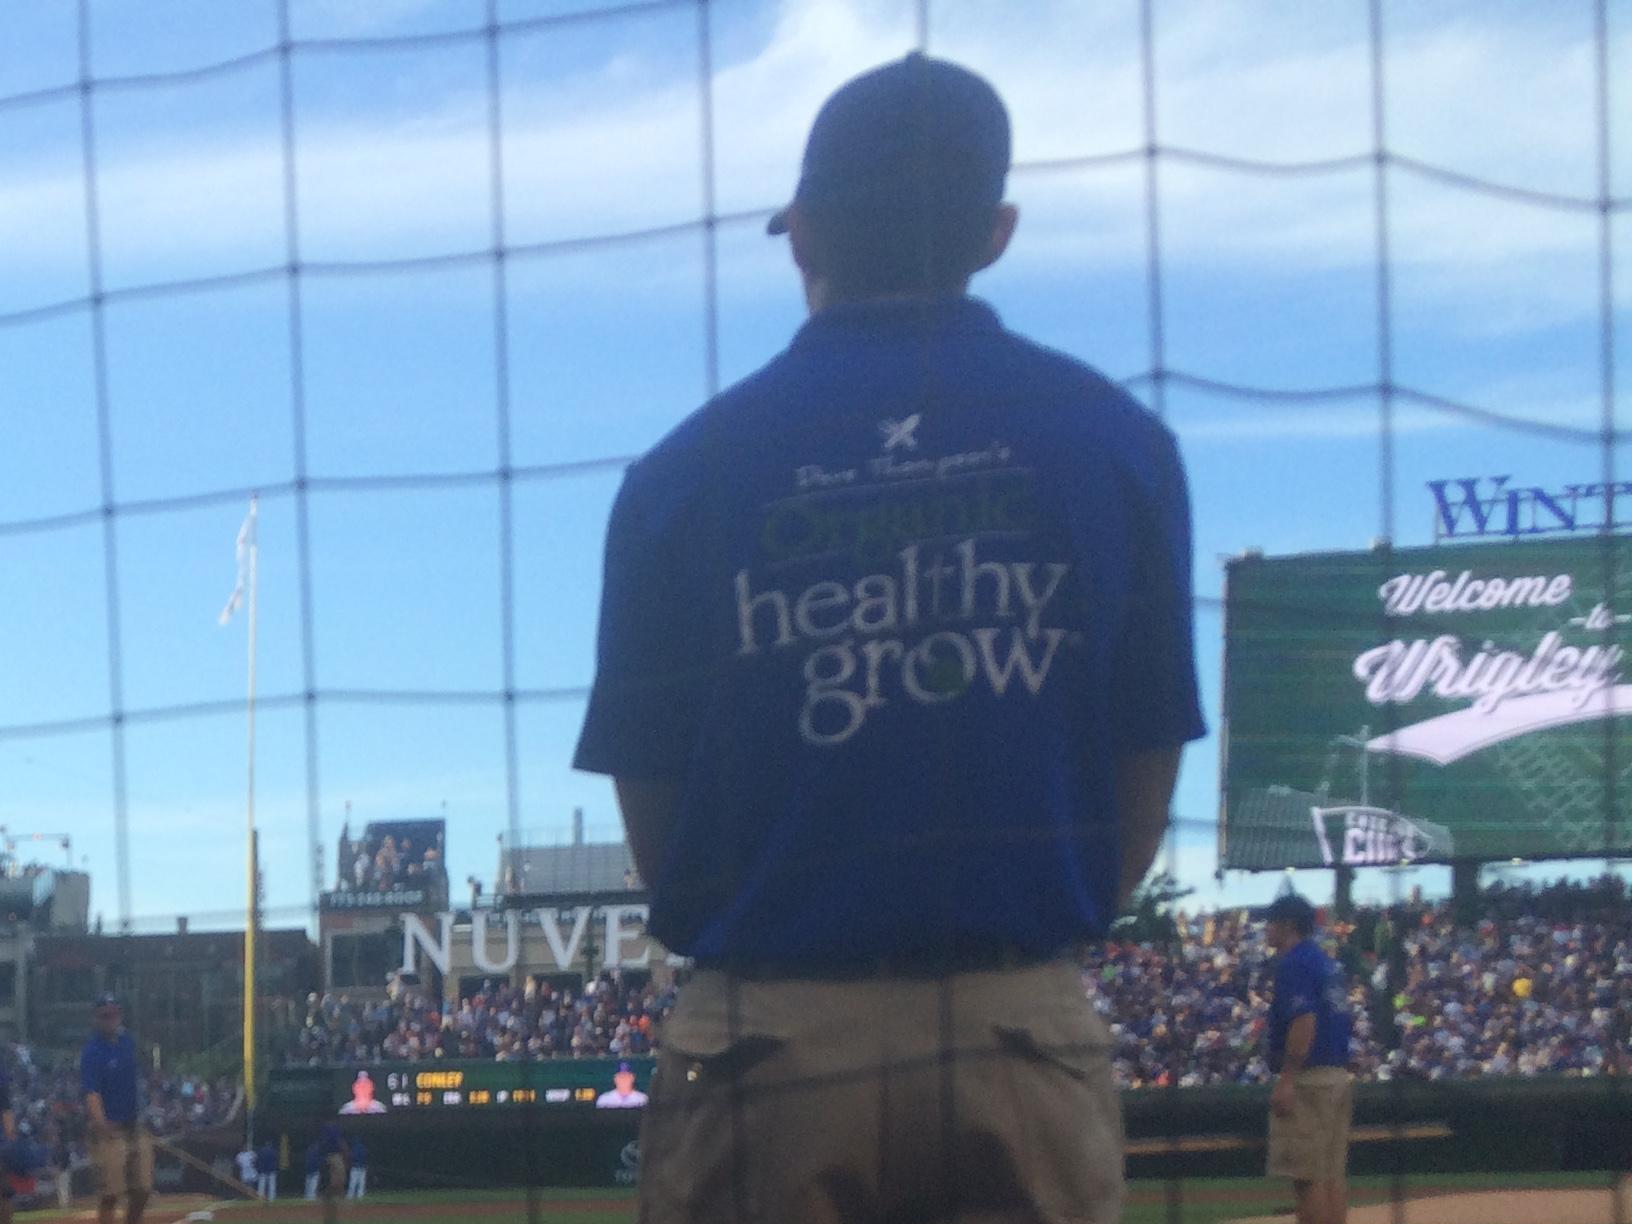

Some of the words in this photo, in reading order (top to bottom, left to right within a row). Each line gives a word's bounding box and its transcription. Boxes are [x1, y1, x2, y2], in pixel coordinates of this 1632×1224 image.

[734, 538, 1068, 655] healthy
[1378, 569, 1572, 617] Welcome
[798, 628, 1068, 745] grow
[1353, 629, 1628, 716] Wrigley
[396, 903, 696, 976] NUVE
